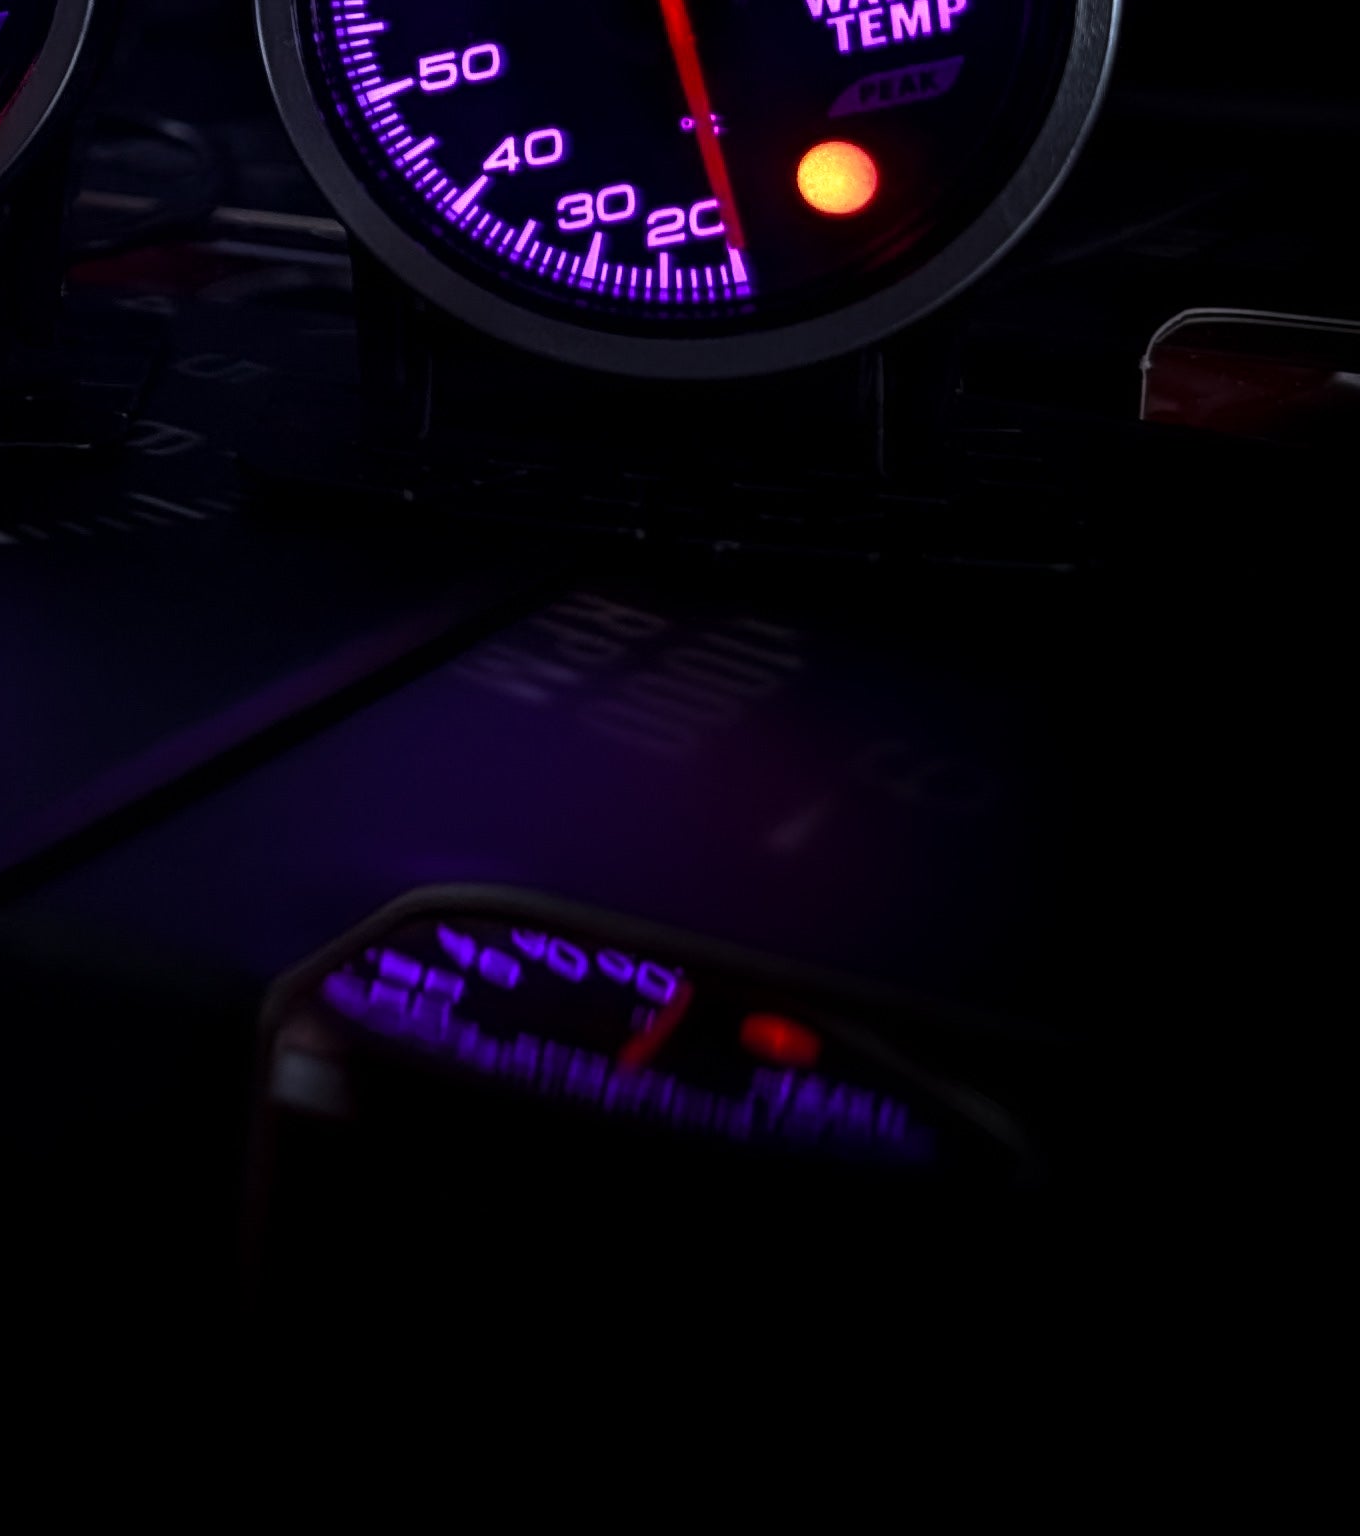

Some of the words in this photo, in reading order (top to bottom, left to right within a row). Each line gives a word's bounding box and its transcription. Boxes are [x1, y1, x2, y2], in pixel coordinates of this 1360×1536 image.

[418, 43, 501, 92] 50
[483, 128, 565, 174] 40
[556, 183, 636, 232] 30
[645, 198, 726, 247] 20
